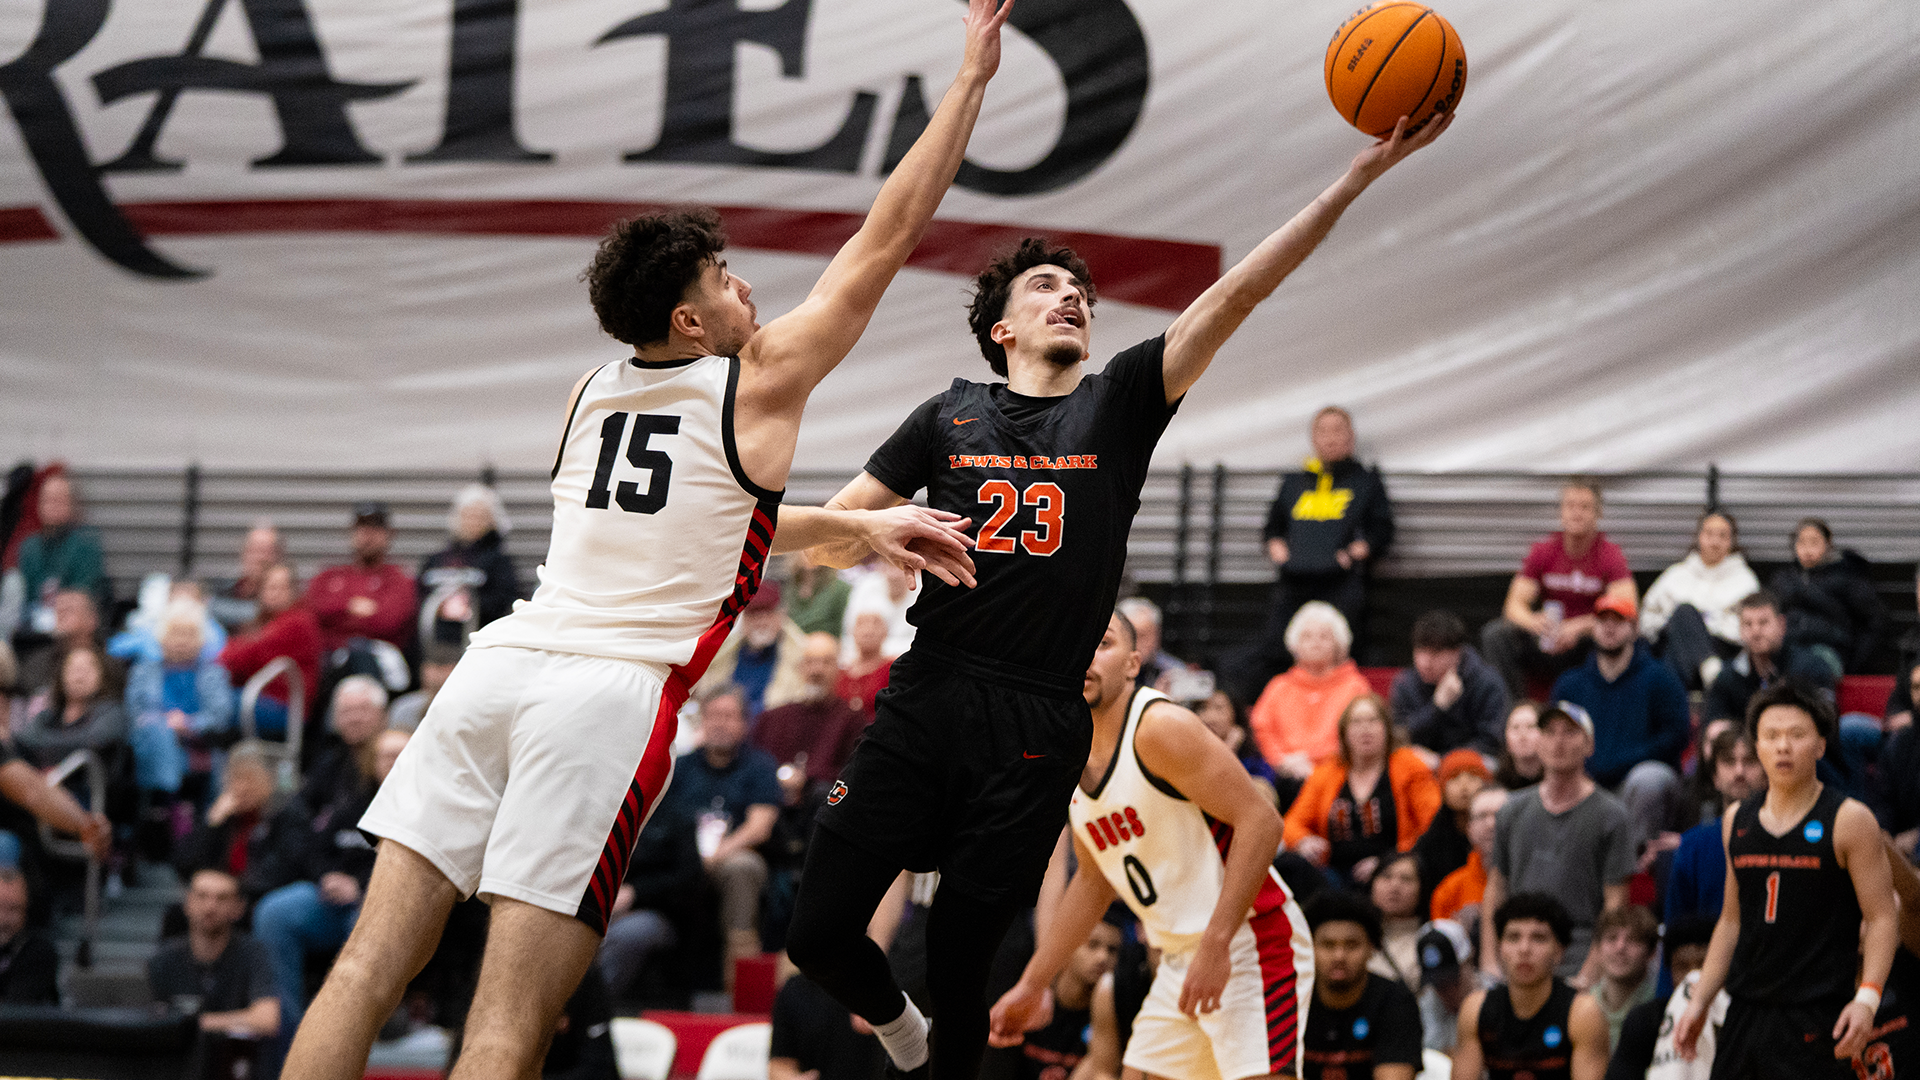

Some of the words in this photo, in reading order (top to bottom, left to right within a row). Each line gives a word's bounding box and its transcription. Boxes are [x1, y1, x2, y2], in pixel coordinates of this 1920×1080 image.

[585, 411, 682, 515] 15
[949, 455, 1012, 469] LEWIS
[1013, 455, 1028, 469] &
[1030, 455, 1098, 470] CLARK
[974, 479, 1066, 557] 23
[1085, 806, 1145, 852] BUCS
[1123, 855, 1158, 907] 0
[1764, 871, 1781, 924] 1
